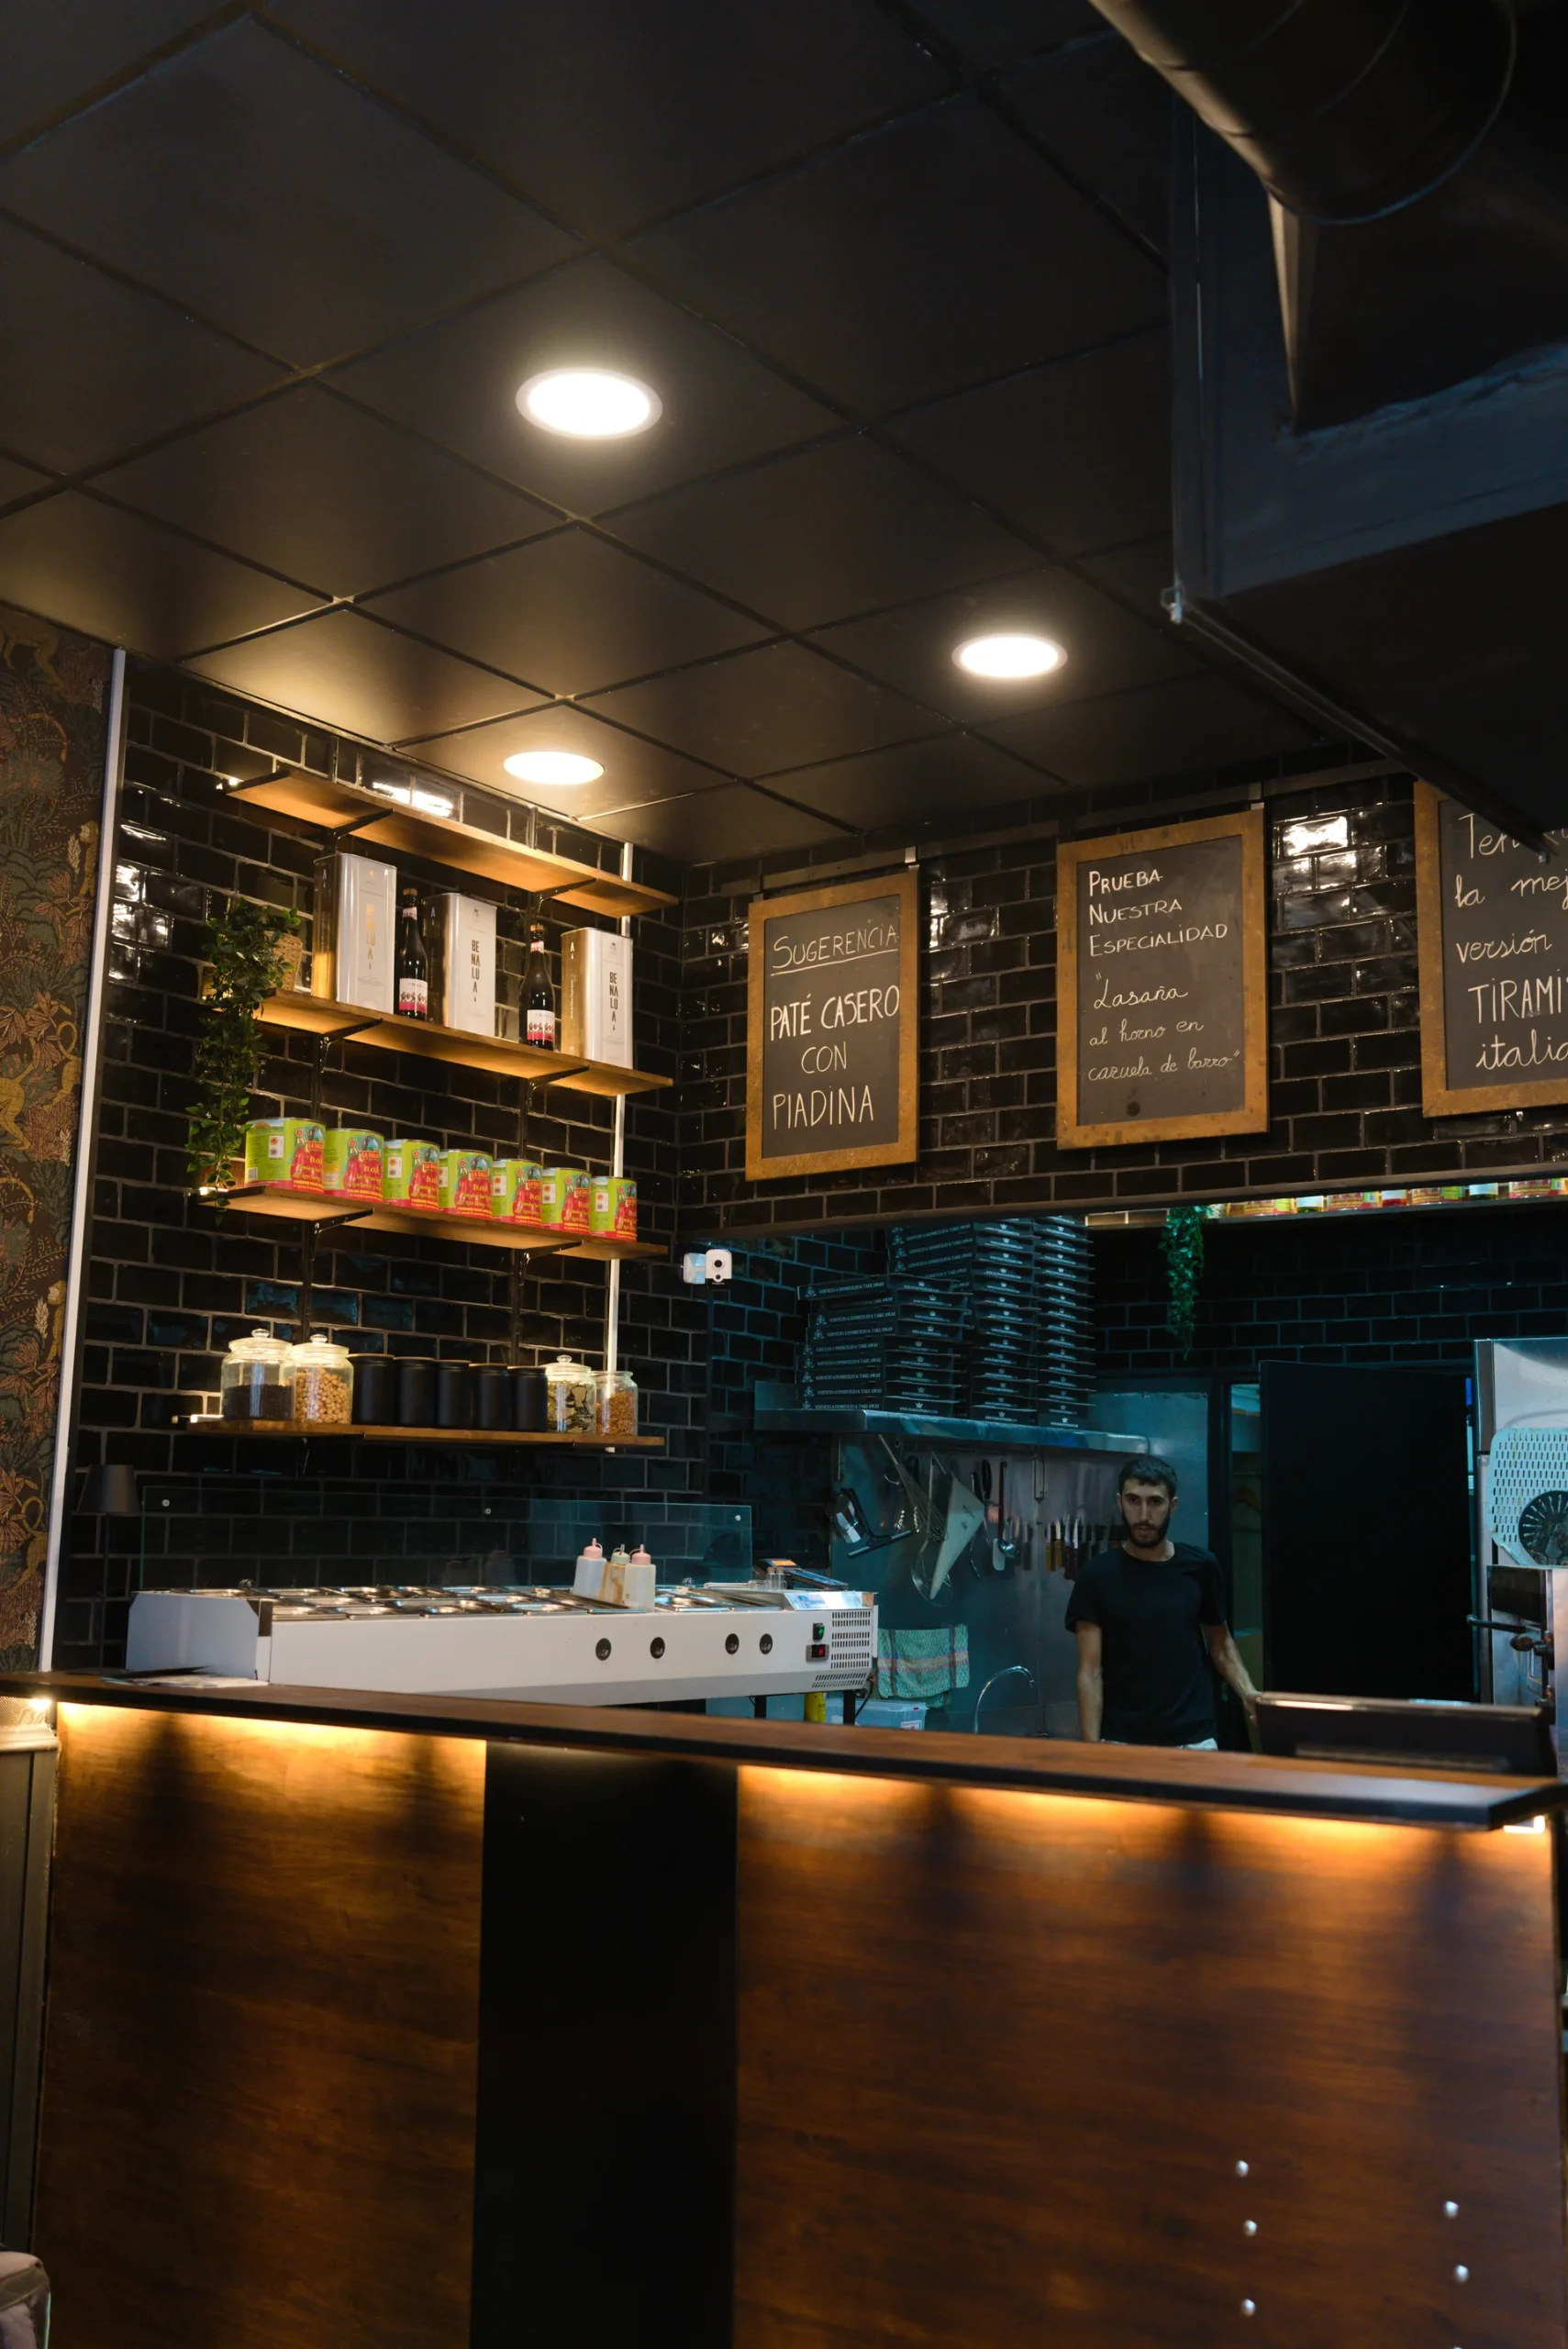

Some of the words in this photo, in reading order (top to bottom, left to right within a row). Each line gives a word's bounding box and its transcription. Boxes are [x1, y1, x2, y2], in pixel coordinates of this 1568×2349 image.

[1088, 868, 1163, 897] PRUEBA
[1454, 874, 1485, 908] la
[1089, 898, 1183, 926] NUESTRA
[772, 923, 899, 969] SUGERENCIA
[1455, 929, 1552, 964] versión
[770, 993, 812, 1041] PATÉ
[820, 985, 900, 1030] CASERO
[1467, 968, 1568, 1024] TIRAMI
[1089, 1027, 1107, 1047] al
[1118, 1018, 1166, 1042] horno
[1175, 1019, 1205, 1033] en
[800, 1041, 847, 1074] CON
[1160, 1052, 1178, 1073] de
[773, 1085, 874, 1130] PIADINA
